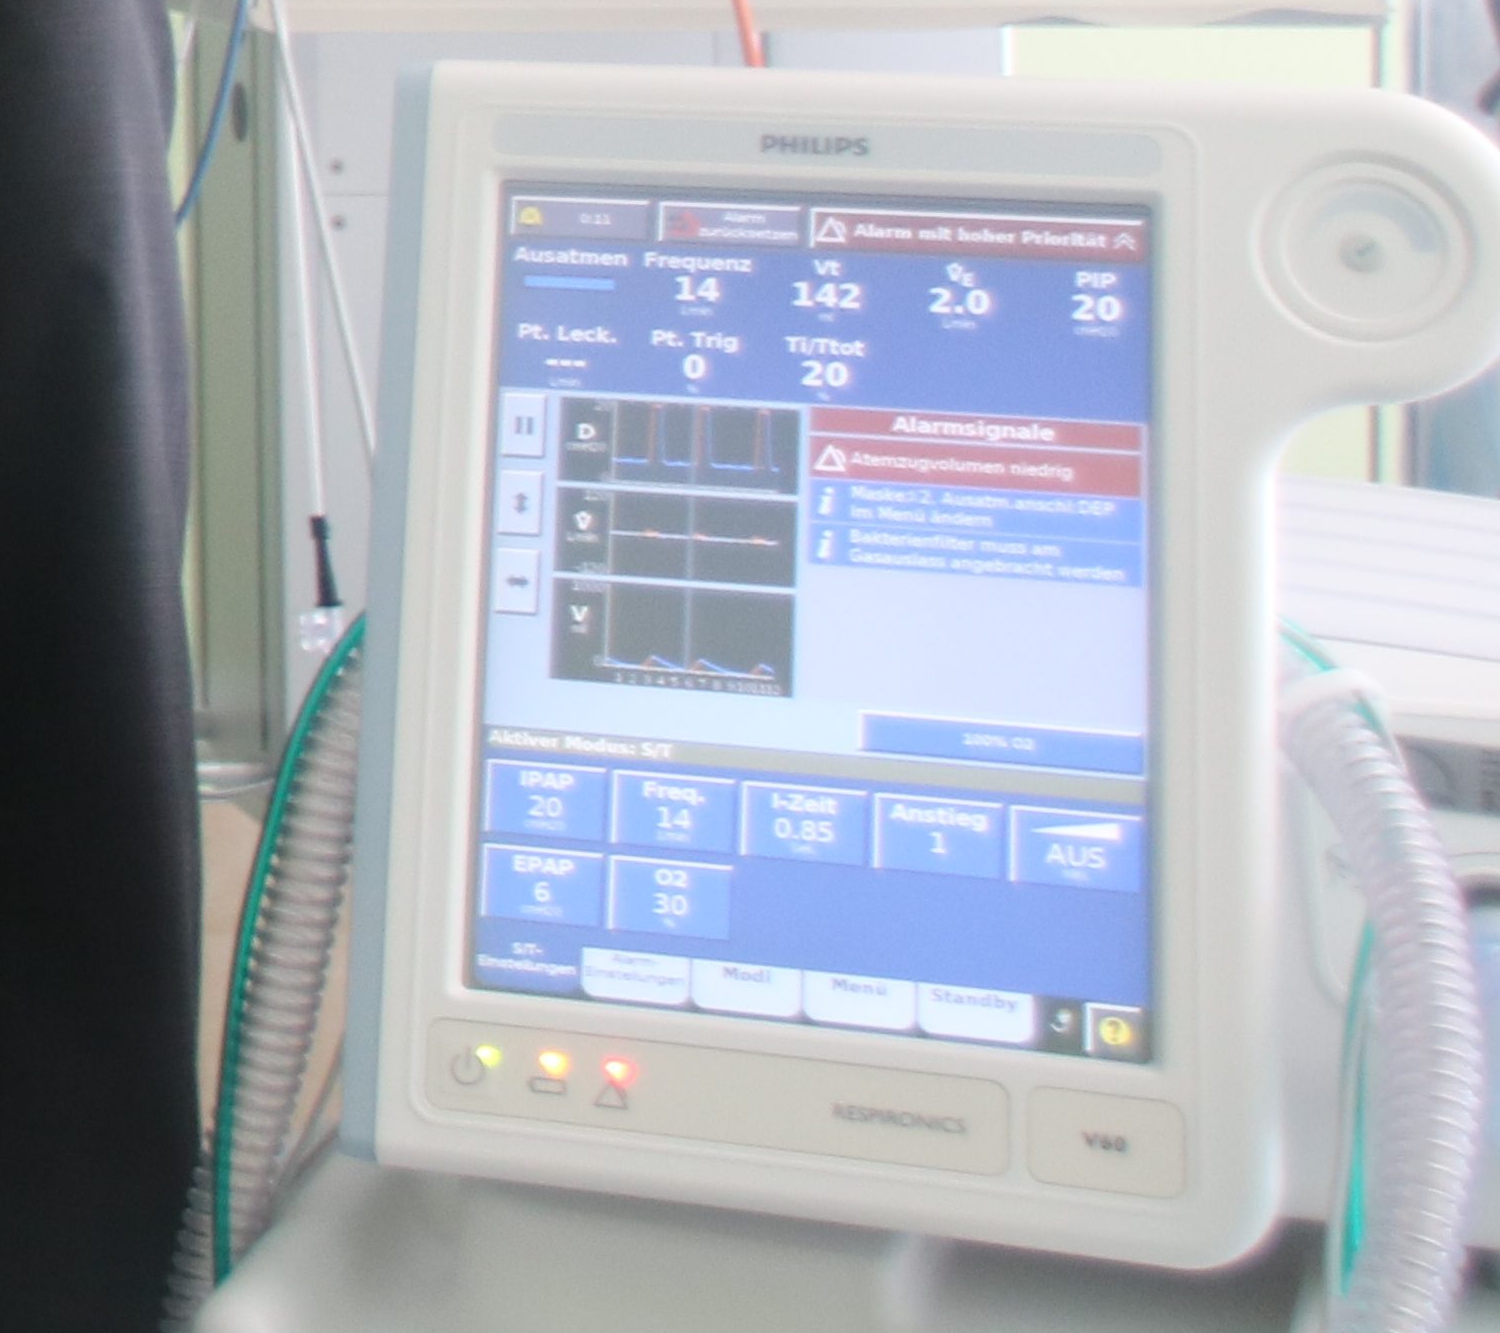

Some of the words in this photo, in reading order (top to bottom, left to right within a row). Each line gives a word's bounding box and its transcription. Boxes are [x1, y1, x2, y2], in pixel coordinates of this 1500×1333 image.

[760, 134, 869, 156] PHILIPS
[854, 222, 912, 240] Alarm
[919, 226, 952, 242] mit
[514, 247, 628, 266] Ausatmen
[643, 252, 753, 273] Frequenz
[813, 259, 841, 277] Vt
[674, 274, 720, 302] 14
[1074, 271, 1118, 289] PIP
[792, 281, 862, 310] 142
[927, 287, 992, 315] 2.0
[1070, 294, 1123, 322] 20
[517, 322, 549, 341] Pt.
[556, 325, 618, 344] Leck.
[651, 329, 684, 348] Pt.
[690, 331, 740, 354] Trig
[786, 336, 867, 358] Ti/Ttot
[682, 354, 707, 380] 0
[800, 360, 850, 388] 20
[577, 422, 596, 440] D
[892, 416, 1056, 442] Alarmsignale
[851, 452, 1004, 475] Atemzugvolumen
[1010, 462, 1074, 481] niedrig
[570, 605, 589, 623] V
[488, 729, 558, 750] Aktiver
[565, 735, 636, 755] Modus:
[641, 742, 673, 759] S/T
[519, 770, 575, 791] IPAP
[642, 781, 706, 805] Freq.
[771, 792, 838, 816] I-Zeit
[528, 795, 563, 819] 20
[656, 806, 693, 830] 14
[890, 803, 988, 832] Anstieg
[773, 817, 835, 844] 0.85
[930, 832, 947, 855] 1
[512, 855, 575, 876] EPAP
[1045, 843, 1107, 869] AUS
[654, 868, 688, 888] O2
[533, 881, 551, 902] 6
[652, 893, 688, 917] 30
[721, 966, 771, 983] Modi
[831, 977, 888, 997] Menü
[930, 988, 1018, 1013] Standby
[831, 1101, 967, 1134] RESPIRONICS
